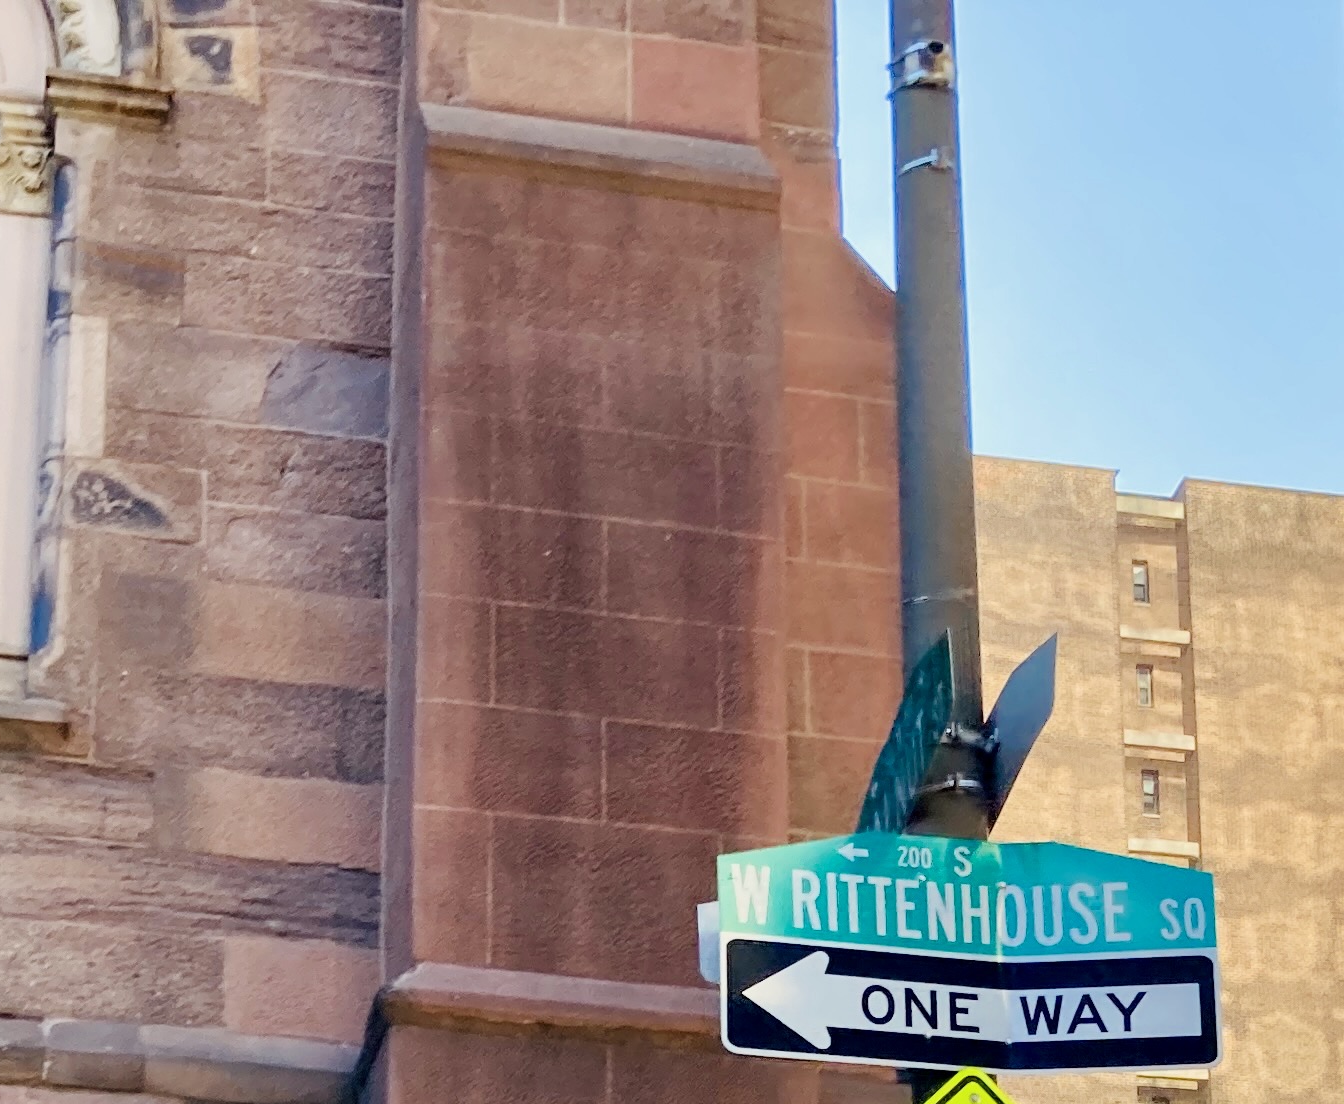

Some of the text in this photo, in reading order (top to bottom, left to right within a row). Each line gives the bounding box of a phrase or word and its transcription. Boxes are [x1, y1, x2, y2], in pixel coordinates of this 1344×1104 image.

[896, 845, 973, 877] 200 S
[731, 862, 1207, 948] W RITTENHOUSE SQ
[860, 983, 1148, 1036] ONE WAY
